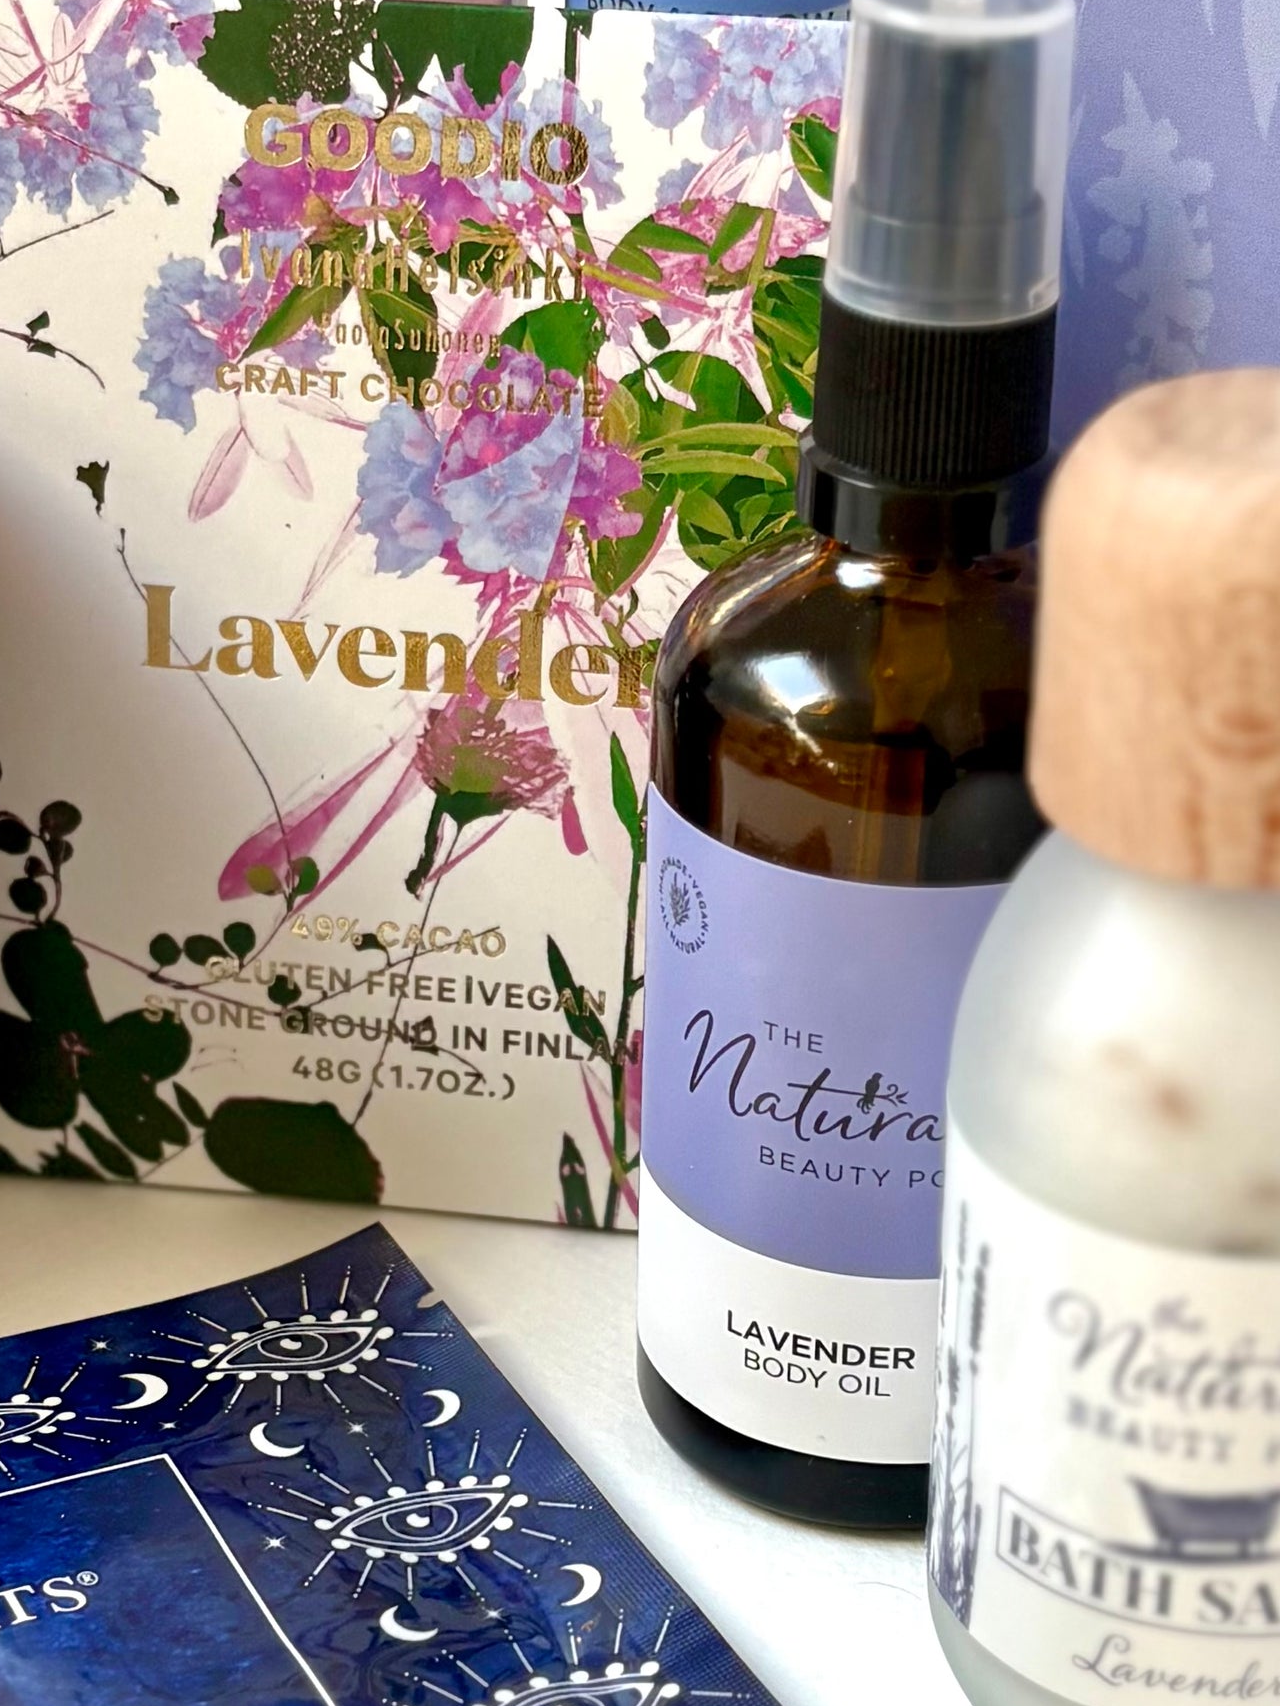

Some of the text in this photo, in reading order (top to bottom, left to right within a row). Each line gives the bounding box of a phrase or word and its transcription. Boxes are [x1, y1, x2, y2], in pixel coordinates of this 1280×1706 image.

[243, 102, 591, 186] GOODIO
[239, 227, 586, 304] IvanaHelsinki
[214, 358, 606, 419] CRAFT CHOCOLATE
[140, 582, 652, 710] Lavender
[375, 920, 508, 958] CACAO
[205, 956, 353, 996] GLUTEN
[143, 994, 641, 1066] STONE GROUND IN FINLAN
[763, 1020, 825, 1054] THE
[291, 1055, 363, 1085] 48G
[683, 1008, 947, 1143] Natura
[758, 1144, 945, 1189] BEAUTY PO
[726, 1309, 916, 1370] LAVENDER
[743, 1347, 892, 1397] BODY OIL
[1064, 1394, 1238, 1464] BEAUTY
[1005, 1511, 1174, 1619] BATH
